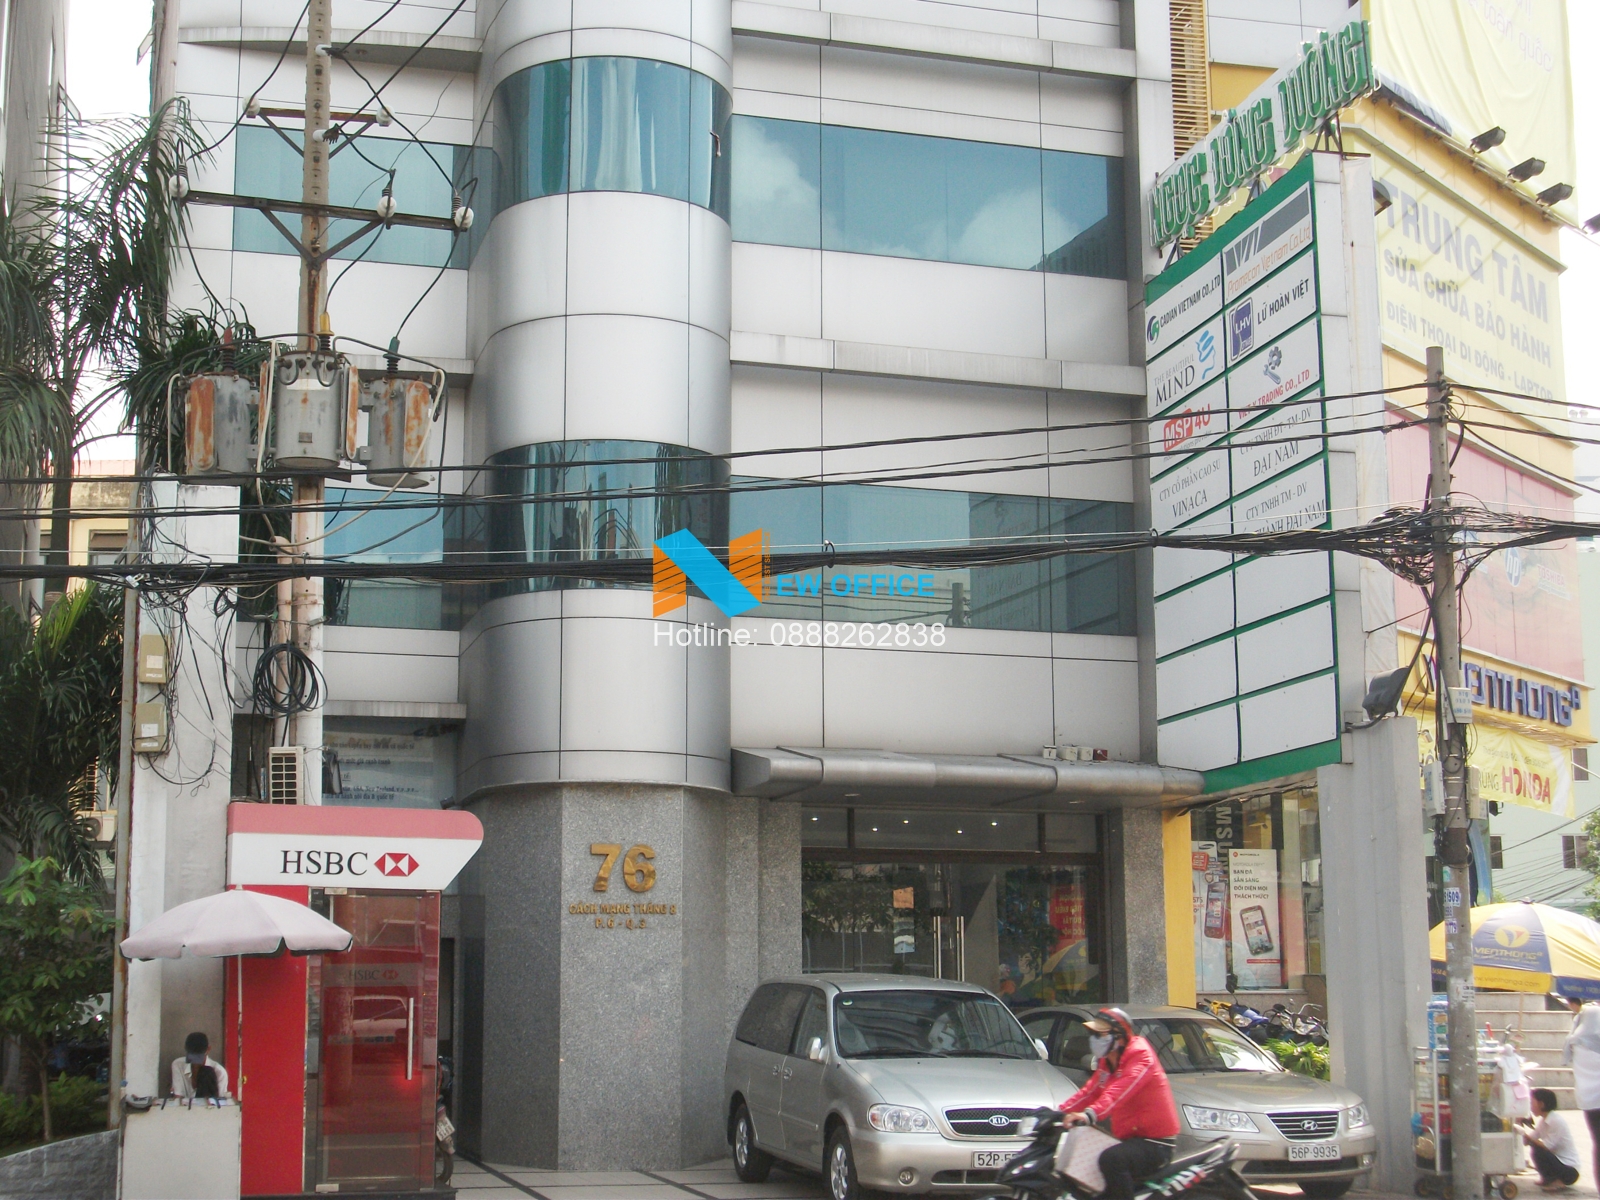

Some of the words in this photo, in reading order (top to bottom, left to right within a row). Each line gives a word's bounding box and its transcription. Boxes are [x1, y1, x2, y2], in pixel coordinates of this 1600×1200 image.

[1379, 177, 1484, 284] TRUNG
[1492, 248, 1549, 324] TÂM
[1160, 301, 1179, 329] CADIAN
[1178, 288, 1201, 316] VIETNAM
[1269, 293, 1290, 317] HOÀN
[1292, 278, 1310, 301] VIỆT
[1235, 311, 1251, 334] LHV
[1474, 301, 1506, 341] BẢO
[1510, 323, 1551, 369] HÀNH
[1154, 372, 1165, 385] THE
[1165, 353, 1195, 379] BEAUTIFUL
[1386, 300, 1418, 334] ĐIỆN
[1420, 317, 1457, 356] THOẠI
[1460, 341, 1471, 363] DI
[1474, 349, 1505, 381] ĐỘNG
[1514, 371, 1554, 406] LAPTOP
[1155, 365, 1196, 407] MIND
[1164, 417, 1192, 449] MSP
[1194, 403, 1211, 430] 4U
[1275, 440, 1300, 466] NAM
[1159, 486, 1171, 502] CTY
[1199, 465, 1212, 481] CAO
[1213, 458, 1221, 471] SU
[1172, 488, 1208, 518] VINACA
[1246, 503, 1261, 521] CTY
[1261, 495, 1280, 515] TNHH
[1279, 489, 1292, 506] TM
[1296, 482, 1308, 499] DV
[1305, 498, 1326, 521] NAM
[1537, 563, 1566, 587] TOSHIBA
[280, 850, 368, 876] HSBC
[590, 843, 656, 893] 76
[569, 900, 598, 915] CÁCH
[633, 901, 668, 915] THÁNG
[669, 904, 678, 915] 8
[348, 969, 380, 981] HSBC
[992, 1117, 1007, 1125] KIA
[1291, 1145, 1338, 1159] 56P-9935
